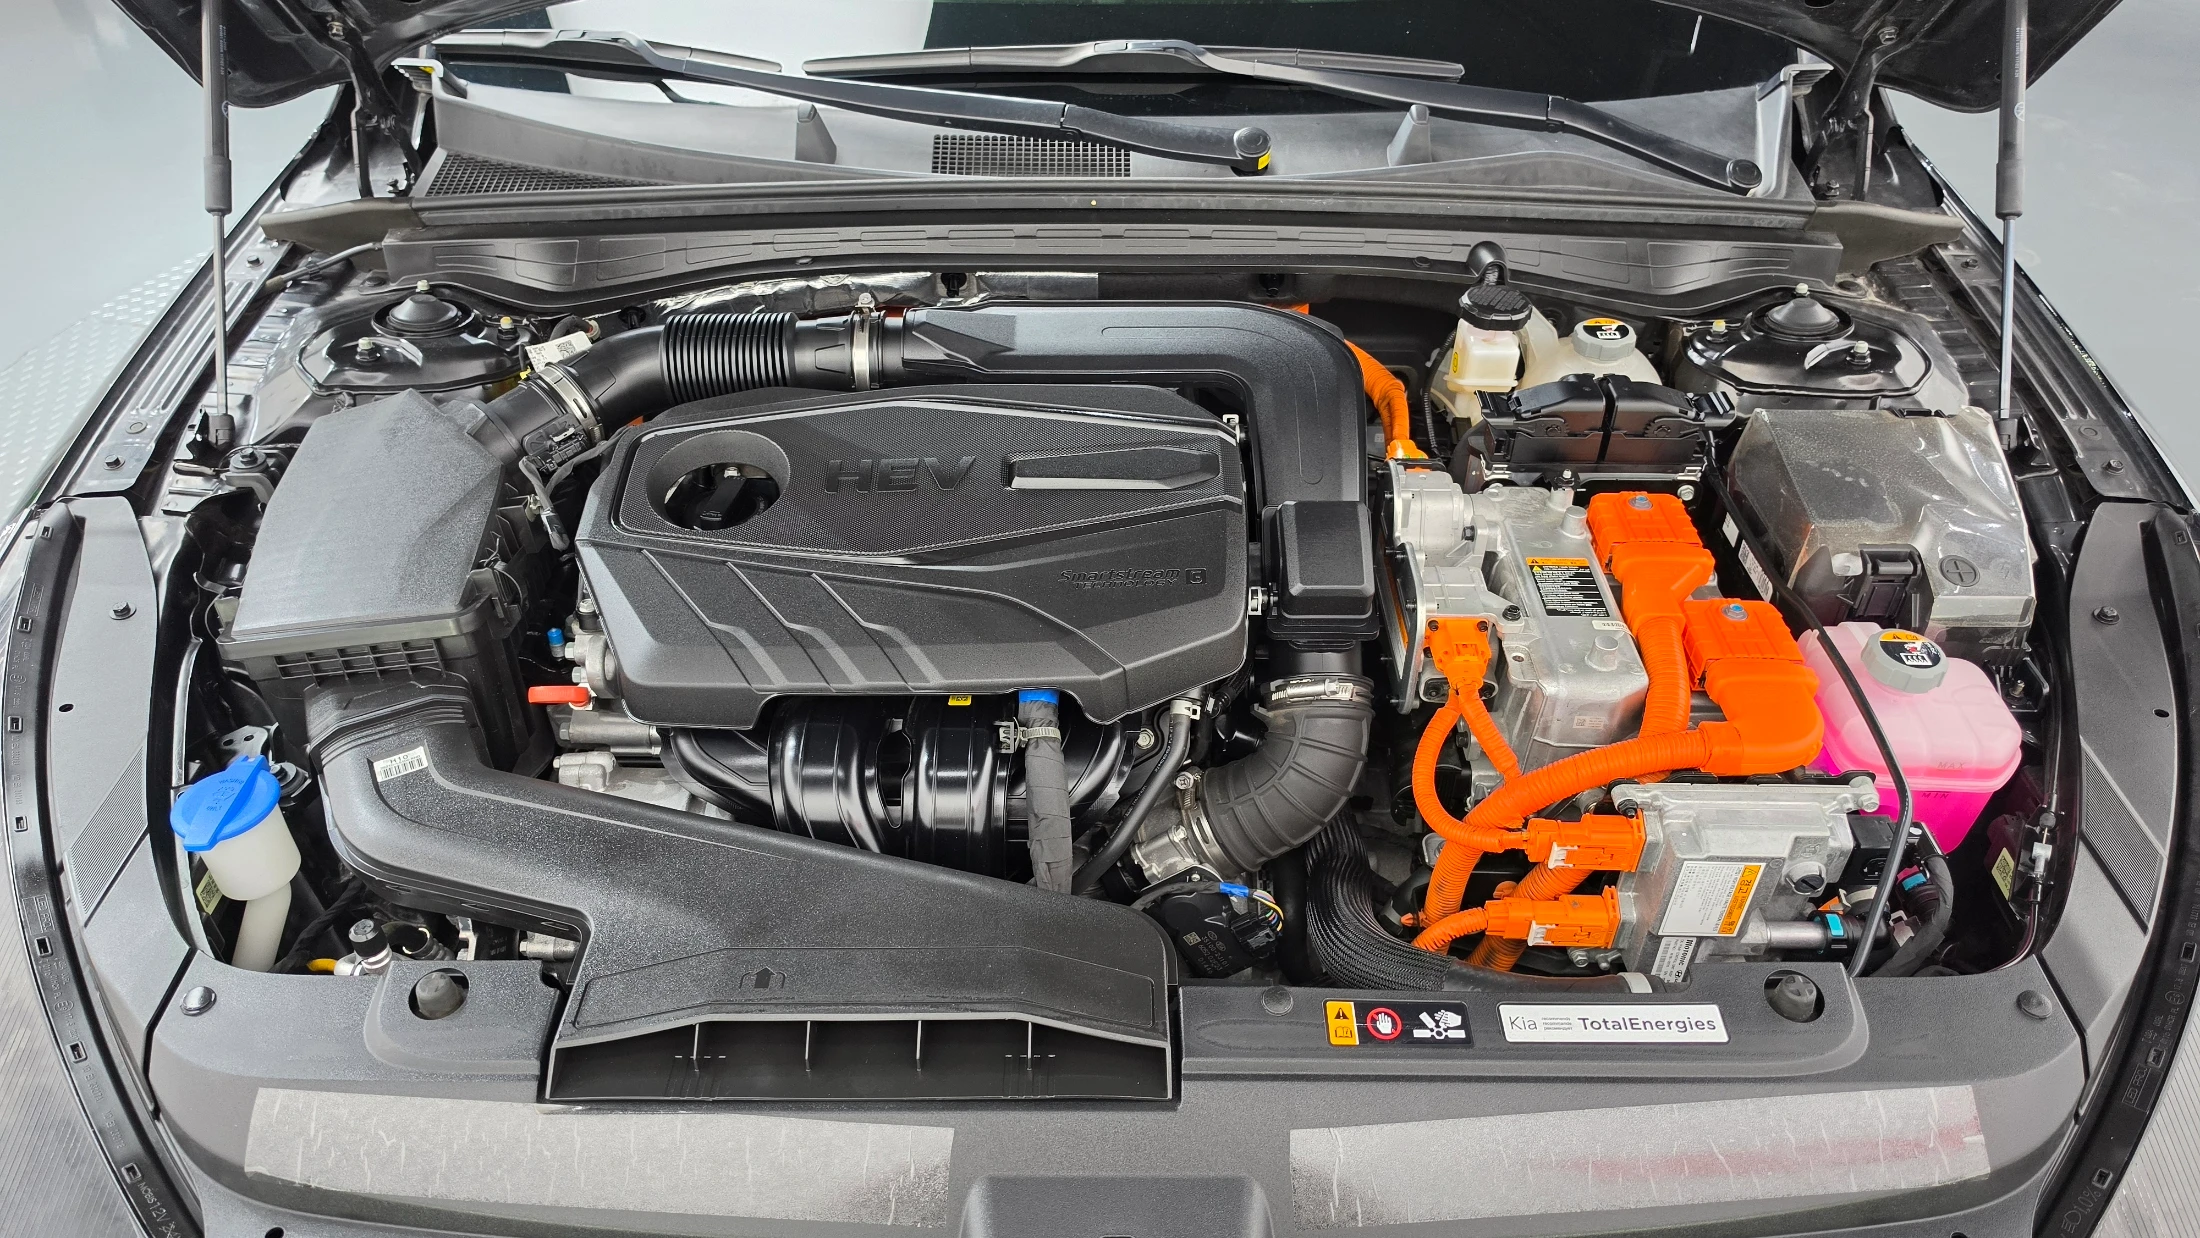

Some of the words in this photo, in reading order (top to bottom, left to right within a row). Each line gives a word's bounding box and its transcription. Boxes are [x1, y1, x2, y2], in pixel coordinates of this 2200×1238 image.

[825, 455, 976, 493] HEV
[1058, 567, 1180, 582] Smartstream
[1073, 579, 1177, 589] TECHNOLOGY
[1509, 1016, 1537, 1030] Kia
[1578, 1017, 1716, 1033] TotalEnergies
[2124, 1086, 2137, 1104] LED
[148, 1199, 171, 1222] 12V
